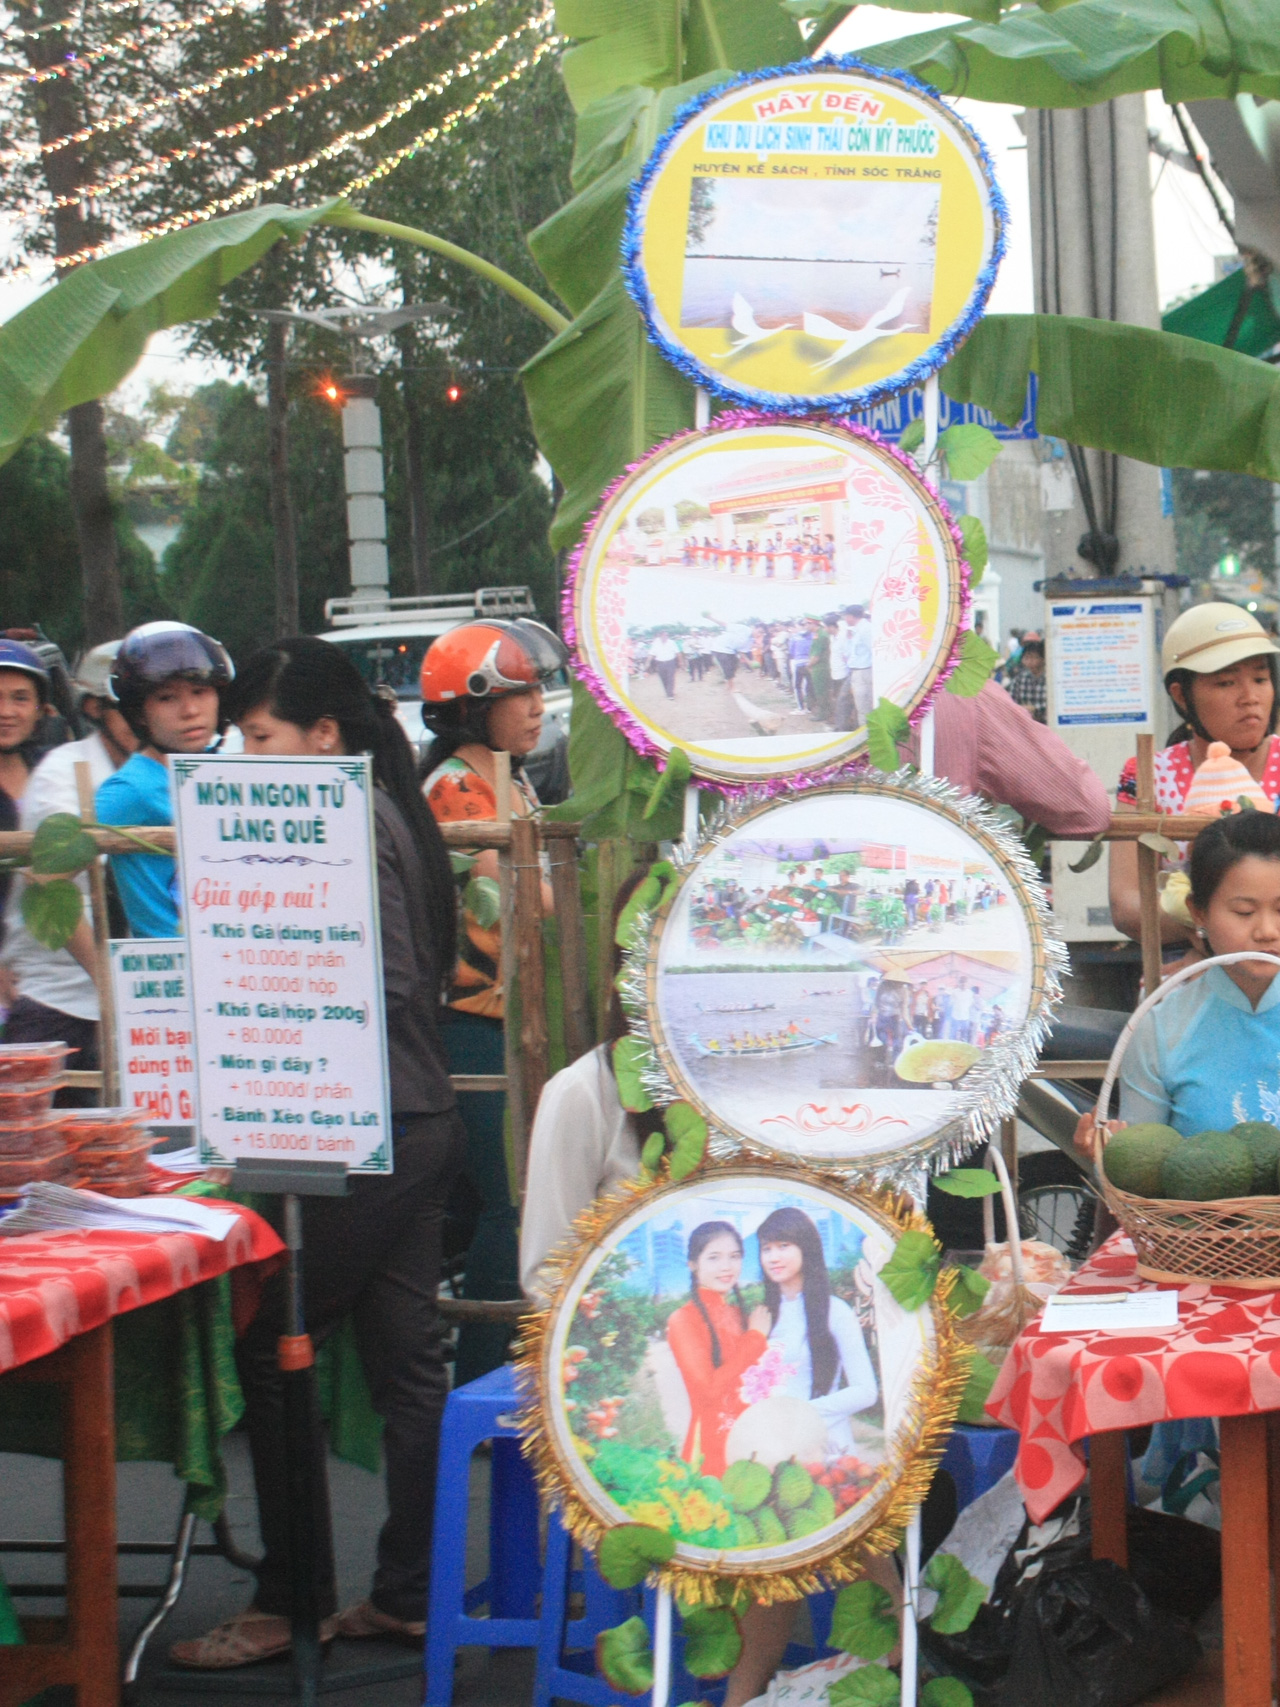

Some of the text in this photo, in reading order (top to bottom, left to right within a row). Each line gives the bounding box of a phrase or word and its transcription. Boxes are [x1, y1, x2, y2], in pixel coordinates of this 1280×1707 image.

[786, 125, 813, 151] SINH
[196, 776, 244, 806] MÓN
[250, 782, 310, 807] NGON
[219, 812, 327, 844] LÀNG QUÊ
[192, 877, 231, 912] Giá
[238, 883, 276, 914] góp
[211, 923, 246, 938] Khô
[217, 1001, 251, 1017] Khô
[128, 1055, 170, 1077] dùng
[220, 1053, 256, 1069] Món
[222, 1106, 266, 1122] Bánh
